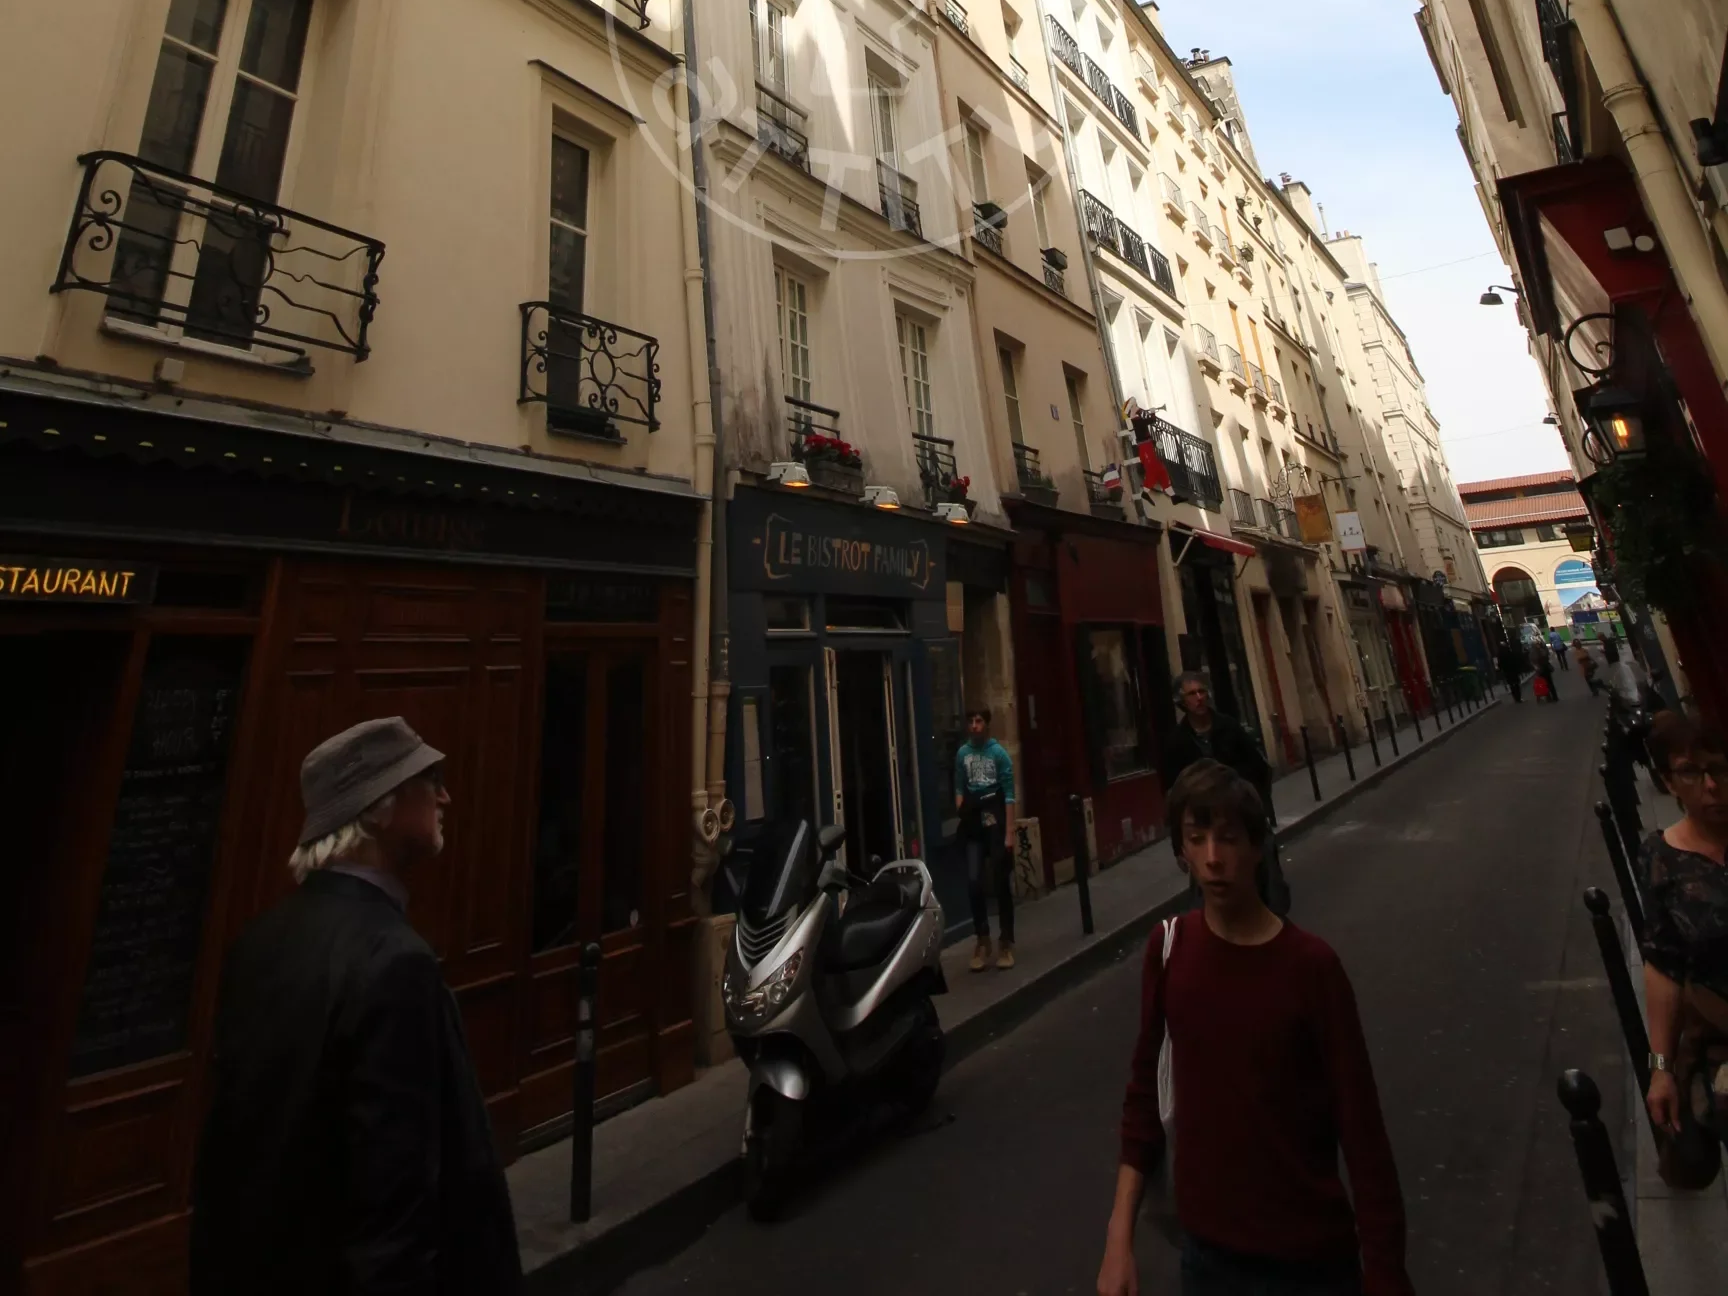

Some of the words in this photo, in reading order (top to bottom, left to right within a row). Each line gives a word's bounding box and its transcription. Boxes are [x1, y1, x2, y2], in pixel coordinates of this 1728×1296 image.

[778, 531, 802, 565] LE
[807, 535, 871, 572] BISTROT
[873, 544, 920, 577] FAMILY
